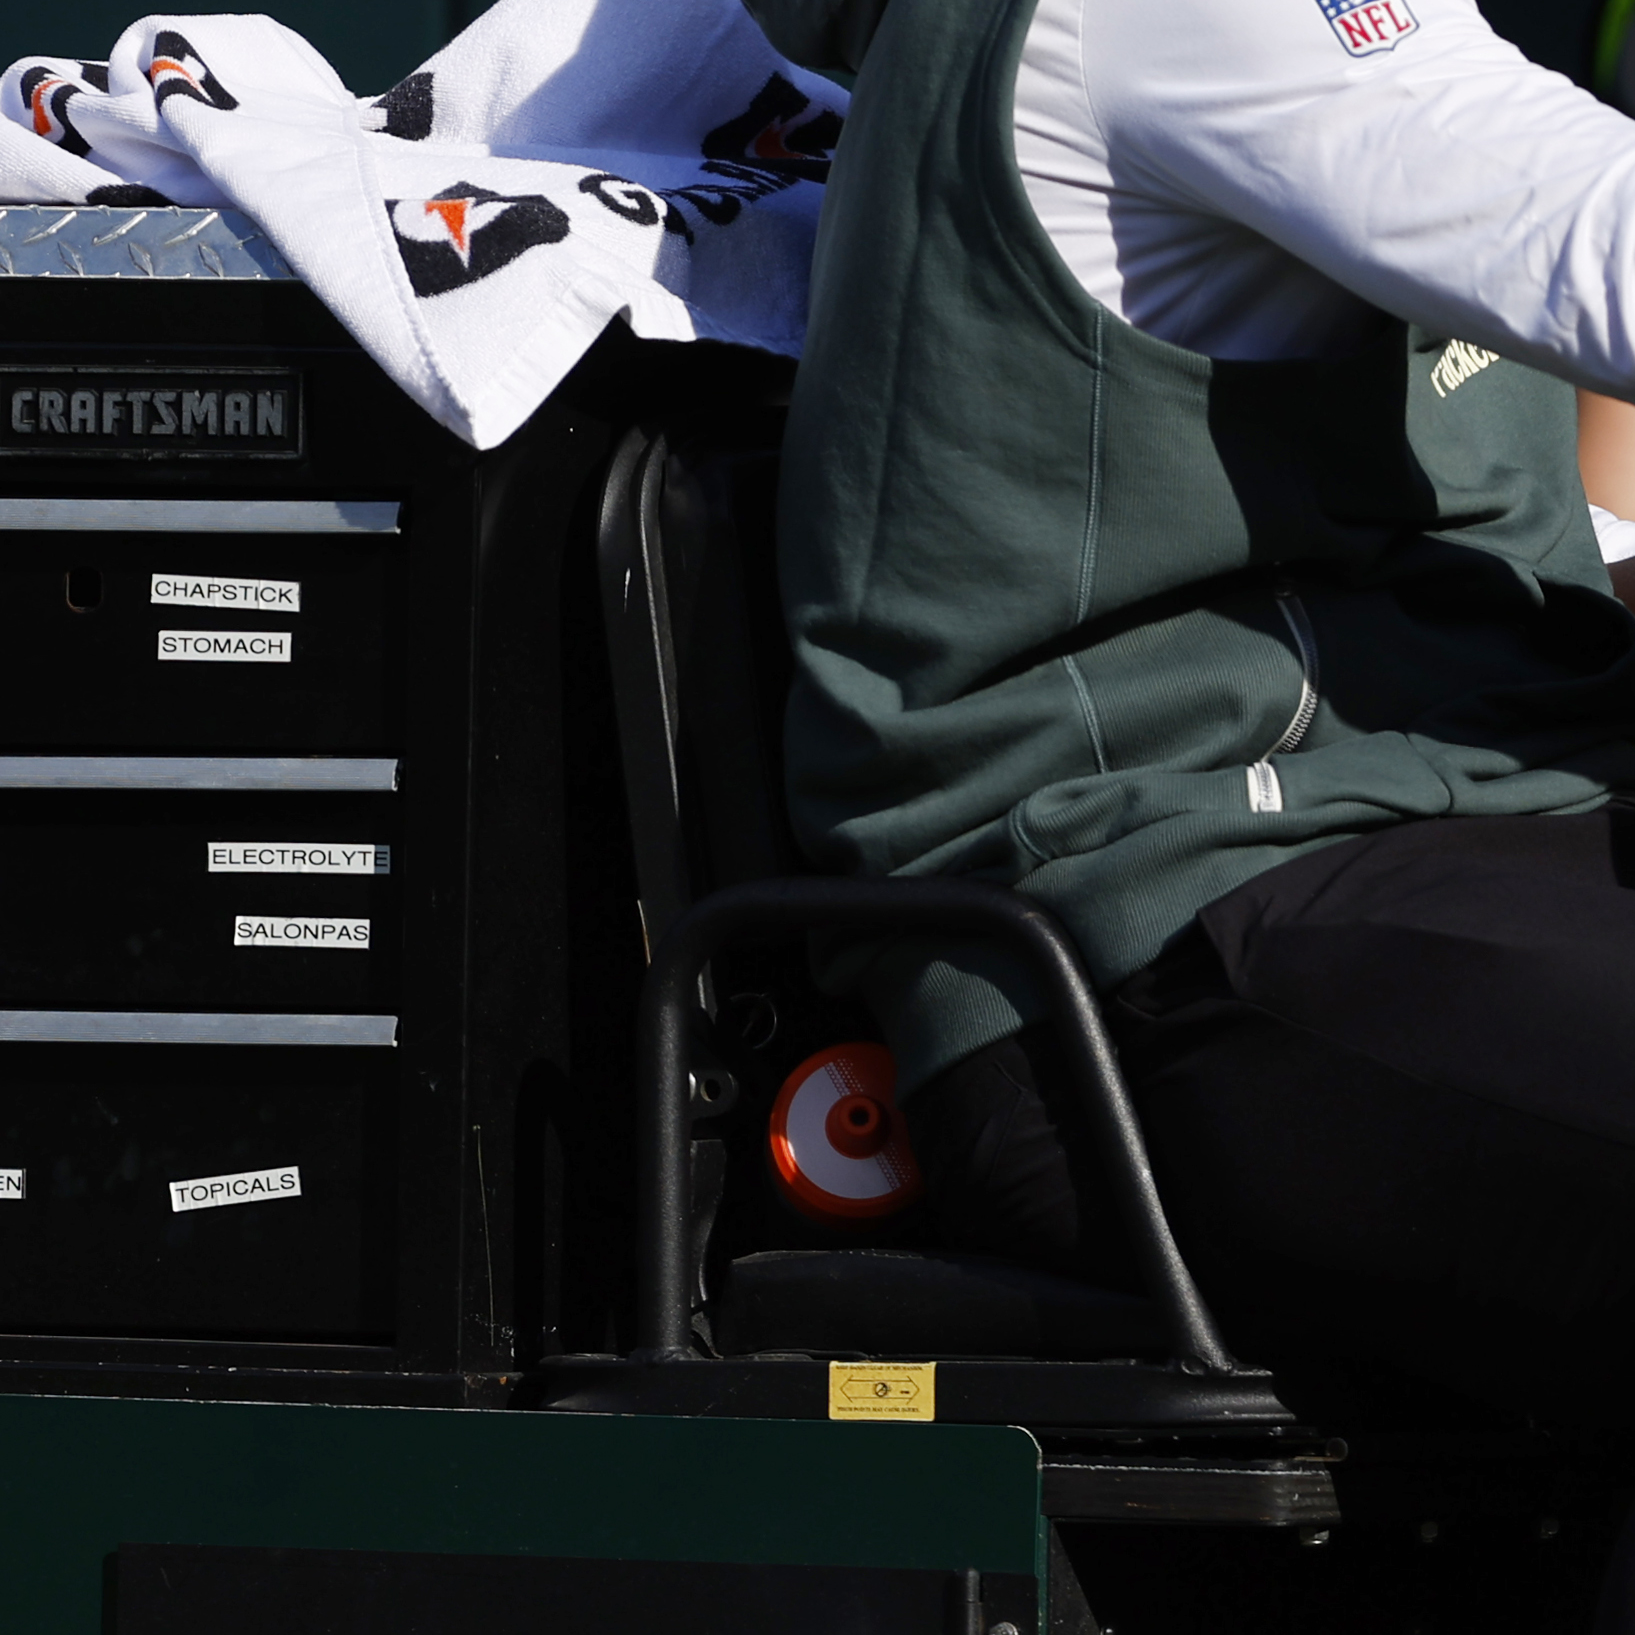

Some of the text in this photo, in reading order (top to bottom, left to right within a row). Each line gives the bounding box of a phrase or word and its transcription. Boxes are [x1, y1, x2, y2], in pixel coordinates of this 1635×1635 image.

[1338, 0, 1411, 49] NFL
[11, 387, 288, 437] CRAFTSMAN
[154, 580, 293, 604] CHAPSTICK
[161, 636, 284, 655] STOMACH
[212, 848, 389, 868] ELECTROLYTE
[236, 922, 369, 941] SALONPAS
[175, 1173, 296, 1203] TOPICALS
